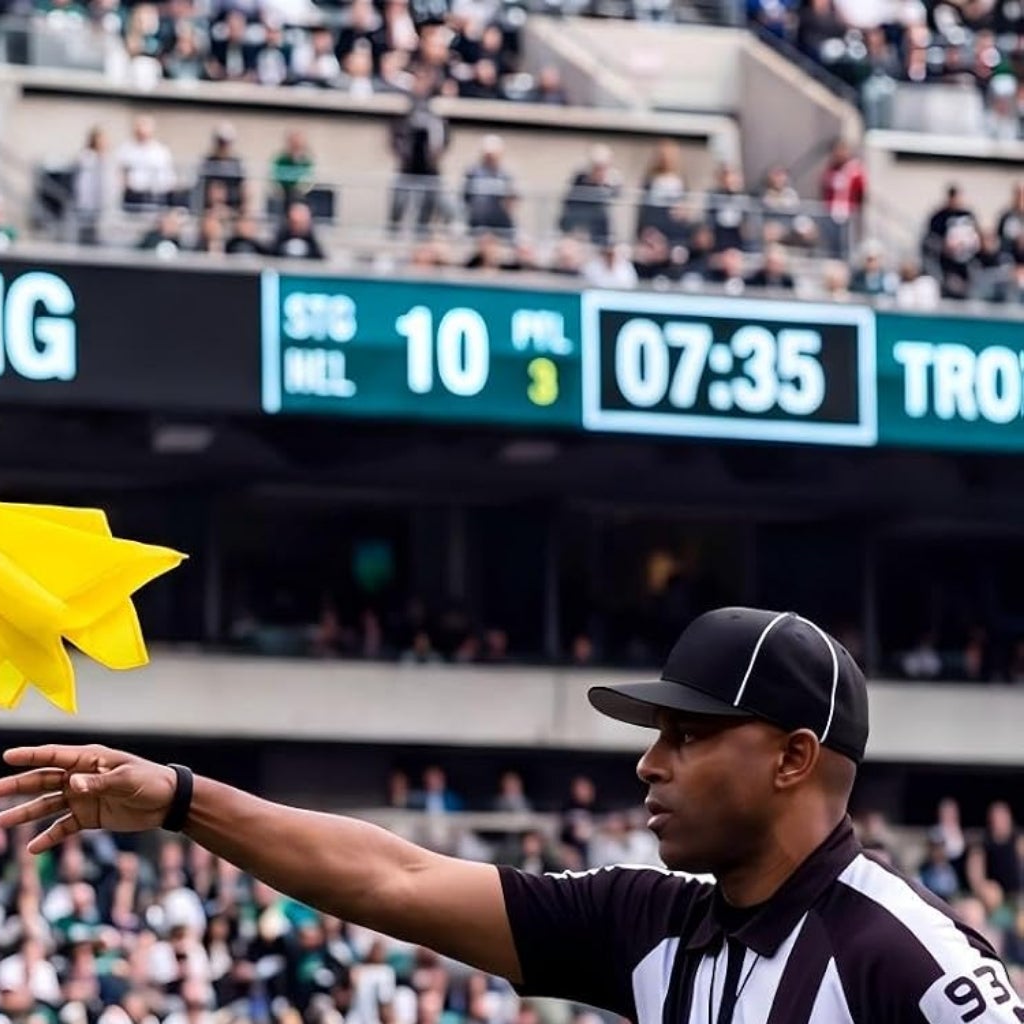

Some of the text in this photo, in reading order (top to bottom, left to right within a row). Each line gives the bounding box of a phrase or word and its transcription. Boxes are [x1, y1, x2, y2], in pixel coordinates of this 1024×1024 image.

[395, 305, 490, 397] 10
[614, 318, 826, 415] 07:35
[892, 340, 1024, 424] TRO
[944, 965, 1011, 1024] 93
